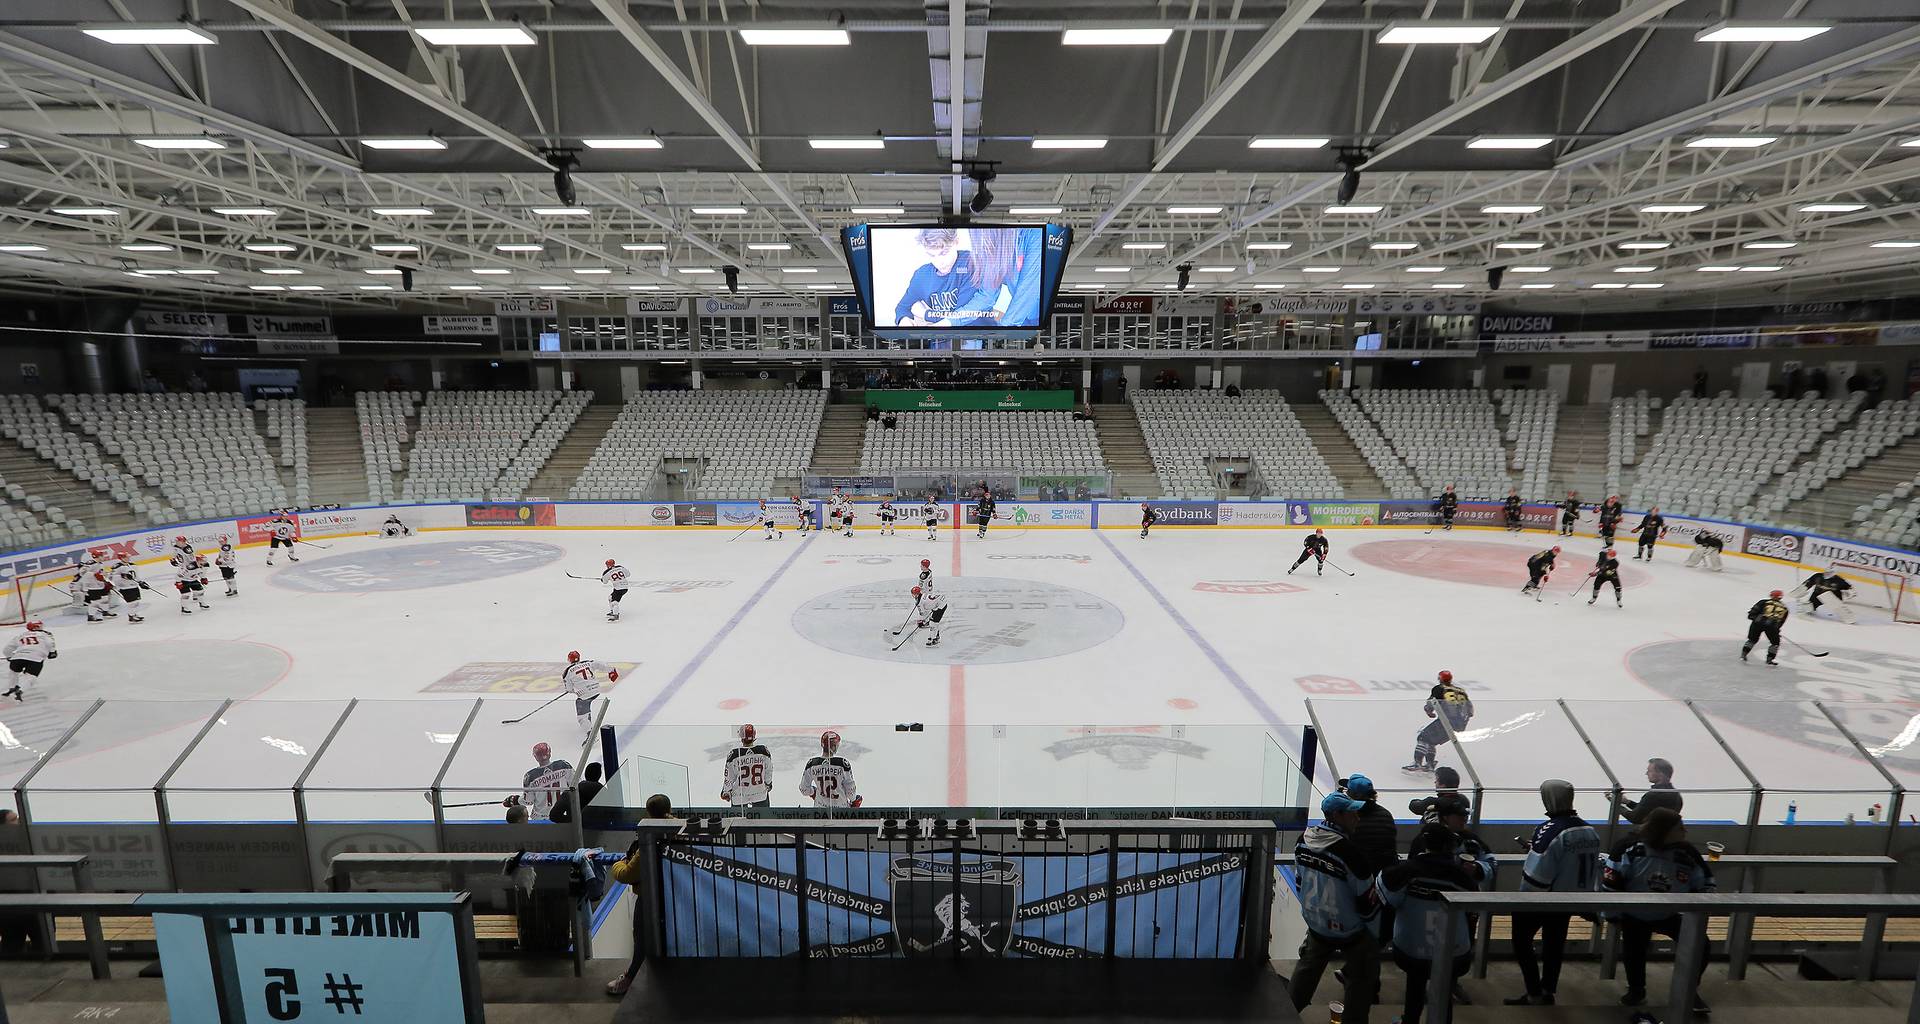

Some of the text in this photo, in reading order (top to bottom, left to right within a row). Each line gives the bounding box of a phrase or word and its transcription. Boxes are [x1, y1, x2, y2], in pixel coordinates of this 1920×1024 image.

[163, 314, 216, 326] SELECT
[266, 317, 328, 333] hummel
[1482, 317, 1553, 332] DAVIDSEN
[1154, 507, 1212, 522] Sydbank
[1236, 511, 1284, 520] Haderslev
[1330, 515, 1357, 524] TRYK
[301, 517, 327, 527] Hotel
[739, 765, 764, 787] 28
[817, 776, 840, 799] 12
[814, 811, 877, 819] DANMARKS
[1152, 811, 1214, 819] DANMARKS
[1216, 811, 1252, 819] BEDSTE
